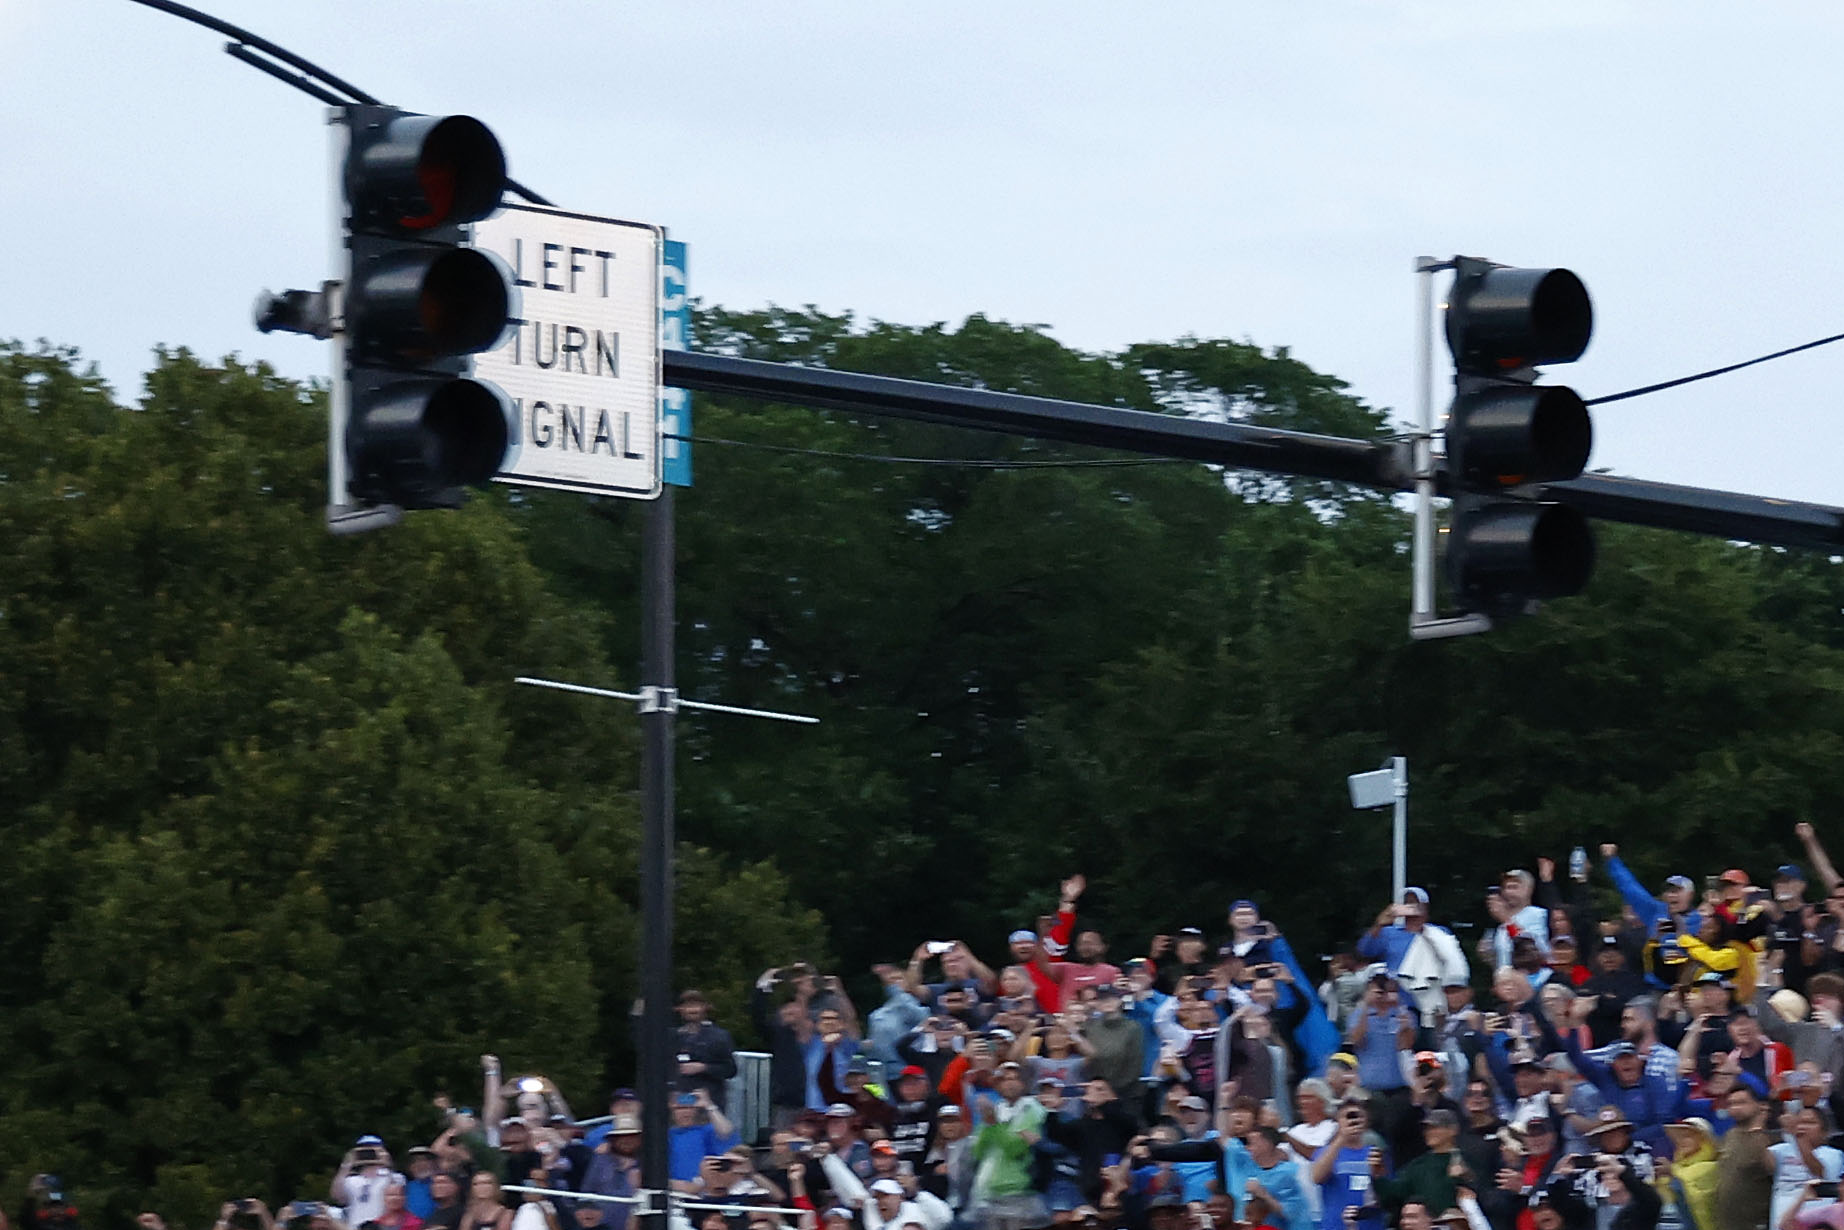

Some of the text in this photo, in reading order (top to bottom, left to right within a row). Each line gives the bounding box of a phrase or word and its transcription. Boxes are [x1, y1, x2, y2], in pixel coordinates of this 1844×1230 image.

[514, 238, 616, 298] LEFT
[506, 318, 620, 378] TURN
[514, 398, 645, 460] IGNAL
